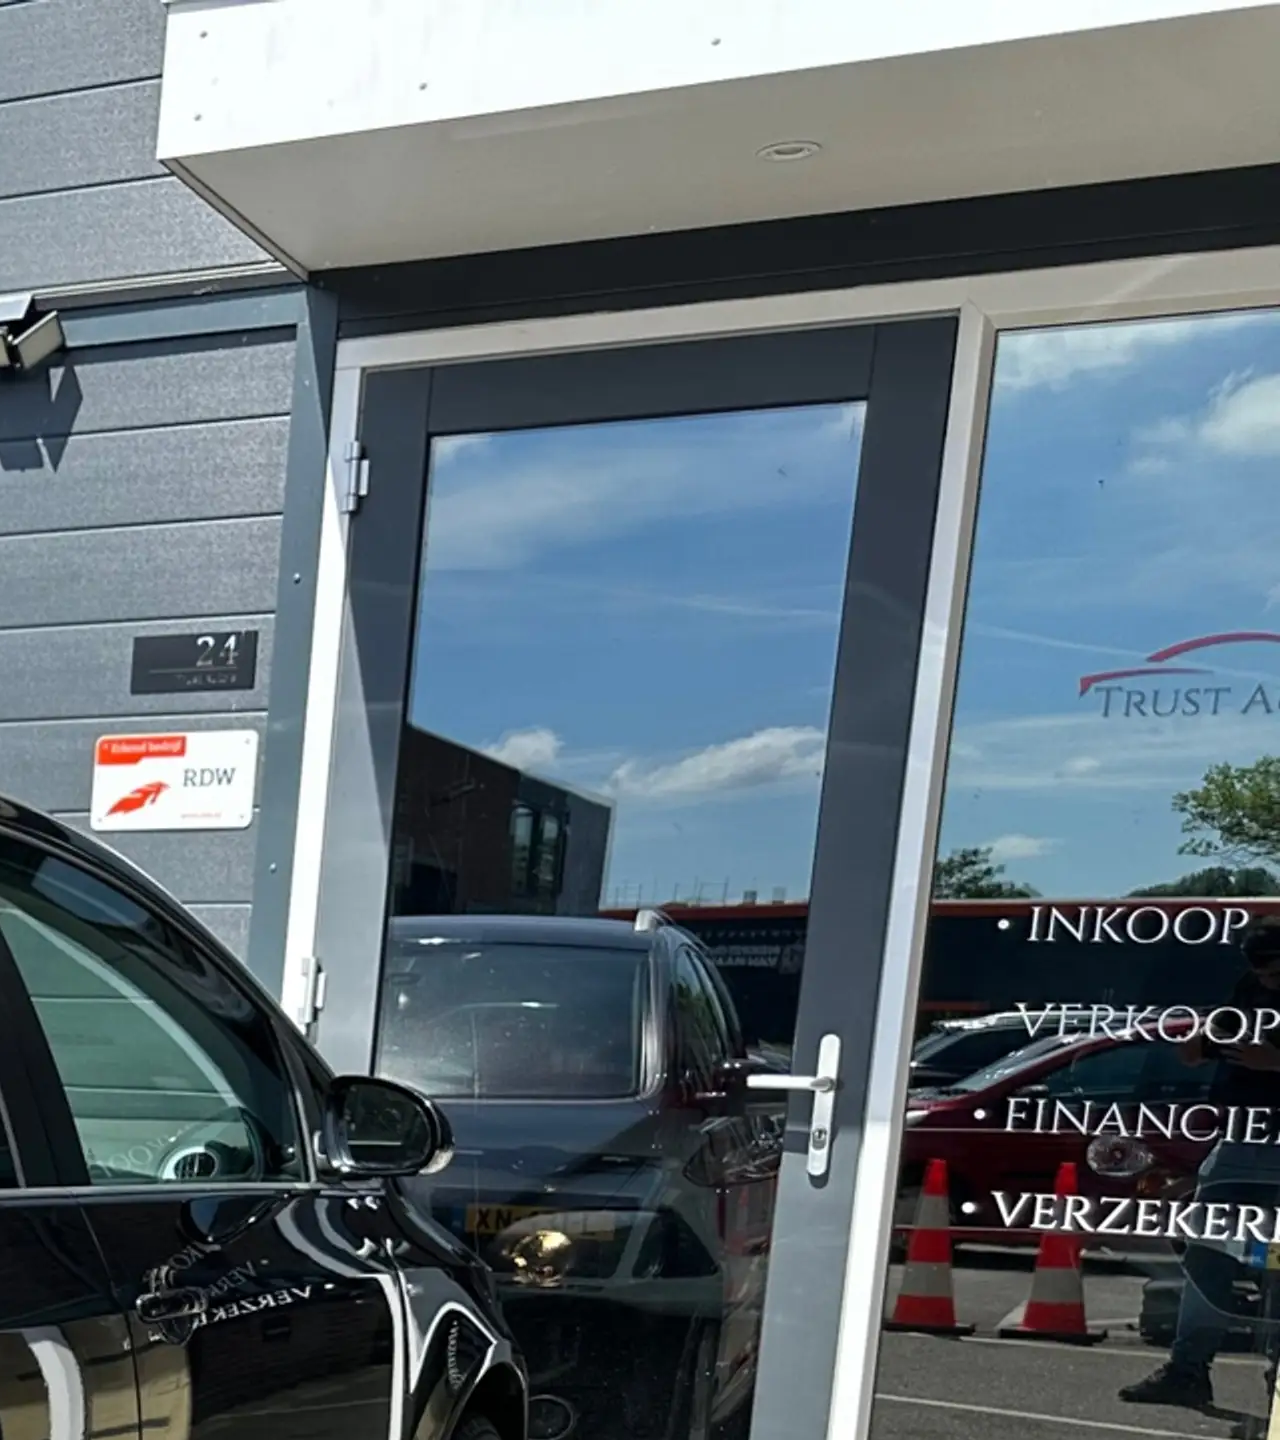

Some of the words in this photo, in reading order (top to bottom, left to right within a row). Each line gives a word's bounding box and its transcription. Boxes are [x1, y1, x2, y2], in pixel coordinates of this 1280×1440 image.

[196, 634, 239, 668] 24
[1094, 685, 1232, 718] TRUST
[1241, 683, 1280, 715] A
[182, 766, 237, 788] RDW
[1027, 906, 1250, 944] INKOOP
[1015, 1002, 1280, 1045] VERKOOP
[1005, 1097, 1280, 1144] FINANCIE
